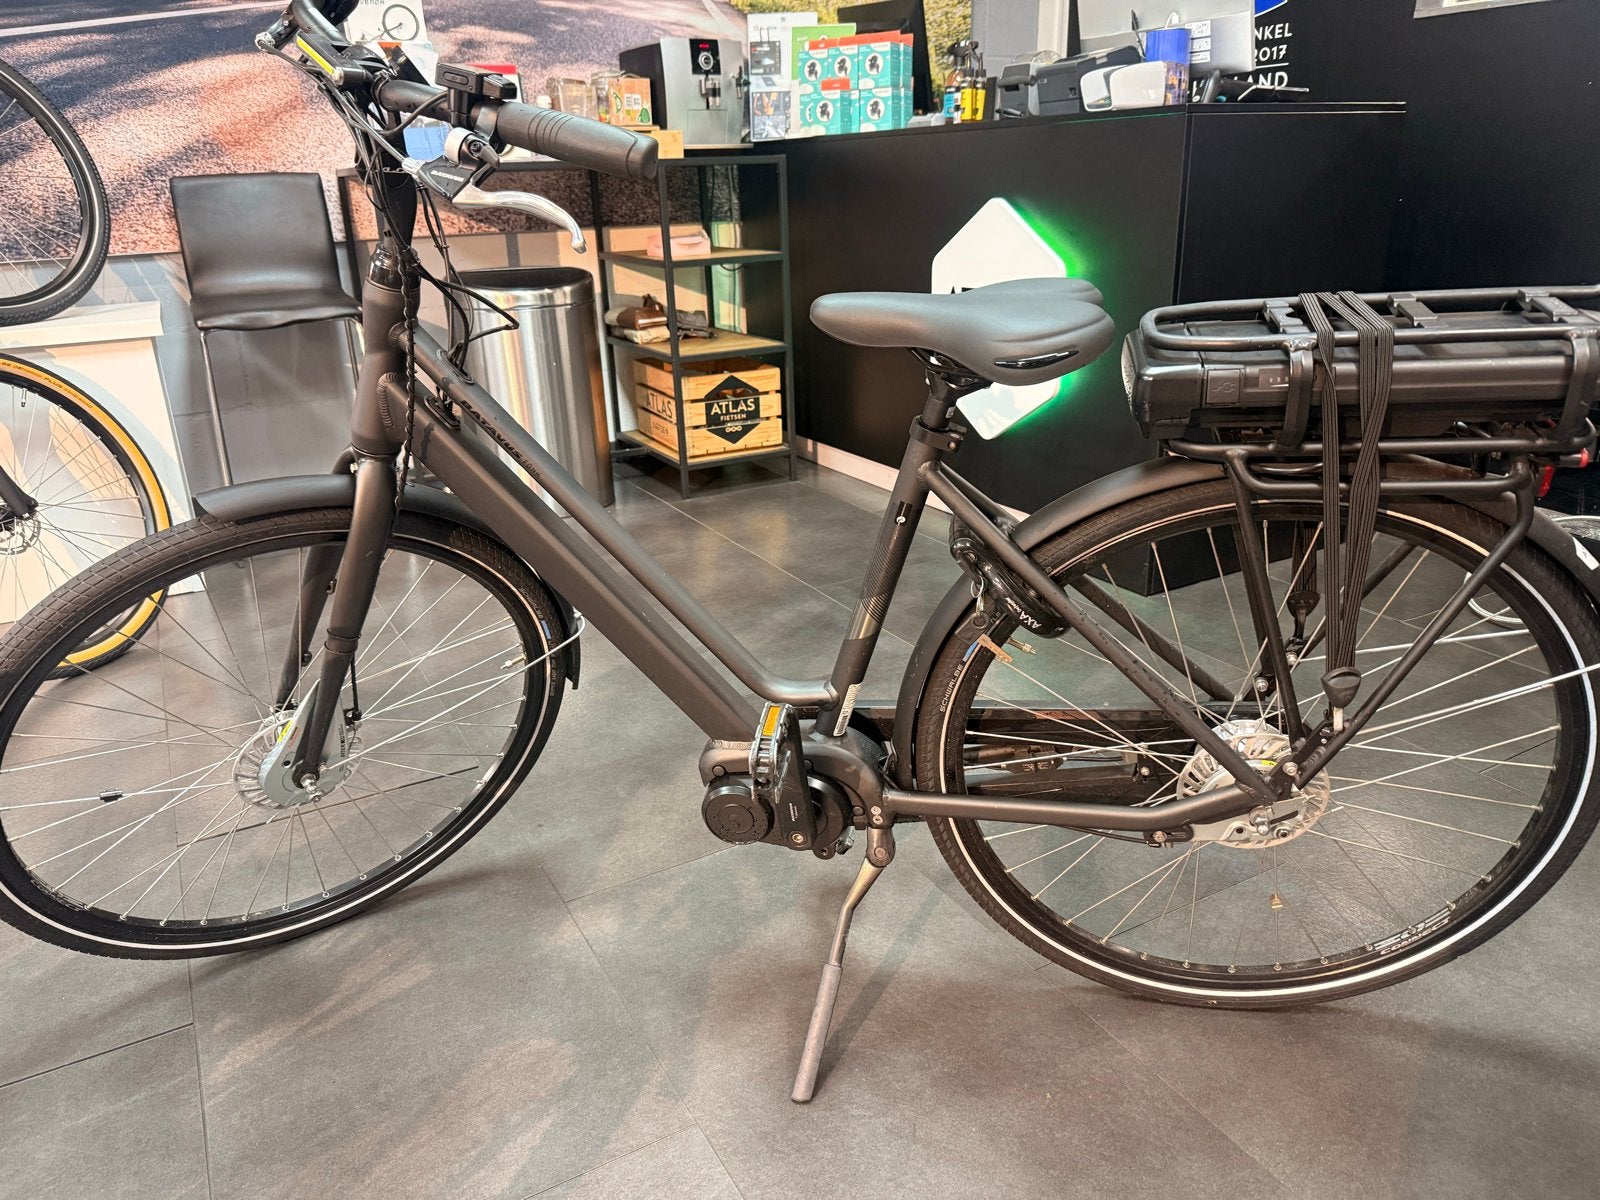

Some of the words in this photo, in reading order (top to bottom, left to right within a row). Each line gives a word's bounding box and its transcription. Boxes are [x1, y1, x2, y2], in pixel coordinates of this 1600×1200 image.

[646, 391, 674, 419] ATLAS
[710, 398, 756, 416] ATLAS
[720, 413, 747, 422] FIETSEN
[460, 399, 523, 460] BATAVUS
[1019, 610, 1043, 629] AXA
[939, 663, 965, 713] SCHWALBE
